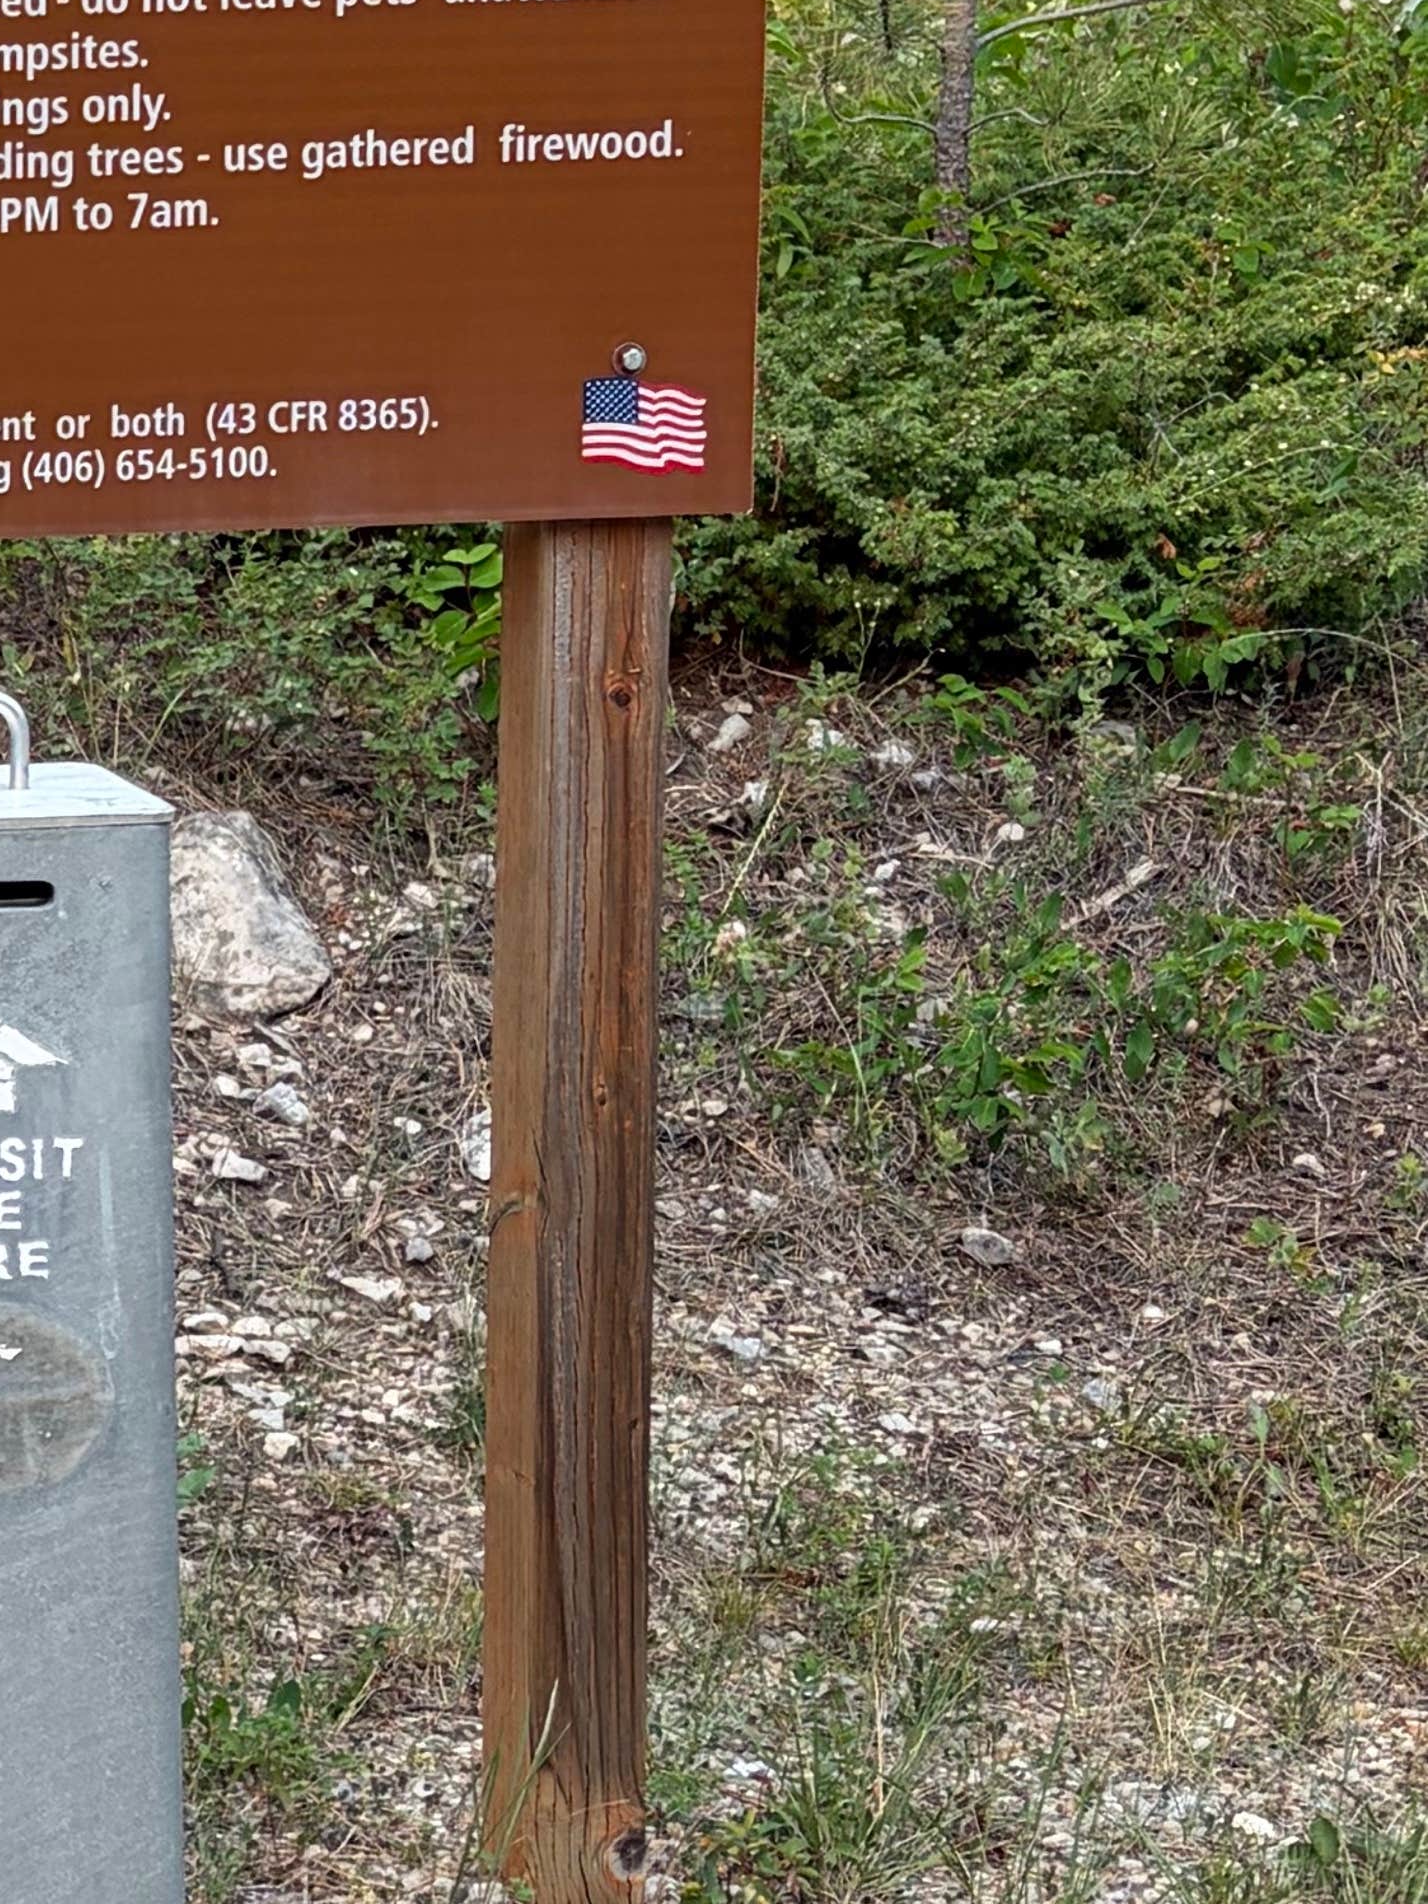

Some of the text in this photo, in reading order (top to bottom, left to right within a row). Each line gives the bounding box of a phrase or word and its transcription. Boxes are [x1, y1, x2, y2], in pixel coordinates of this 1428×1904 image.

[82, 82, 171, 132] only.
[72, 197, 113, 231] to
[127, 192, 219, 229] 7am.
[56, 414, 91, 440] or
[111, 402, 185, 438] both
[206, 402, 256, 442] (43
[267, 400, 328, 434] CFR
[338, 395, 439, 436] 8365).
[22, 448, 105, 491] (406)
[115, 445, 277, 481] 654-5100.
